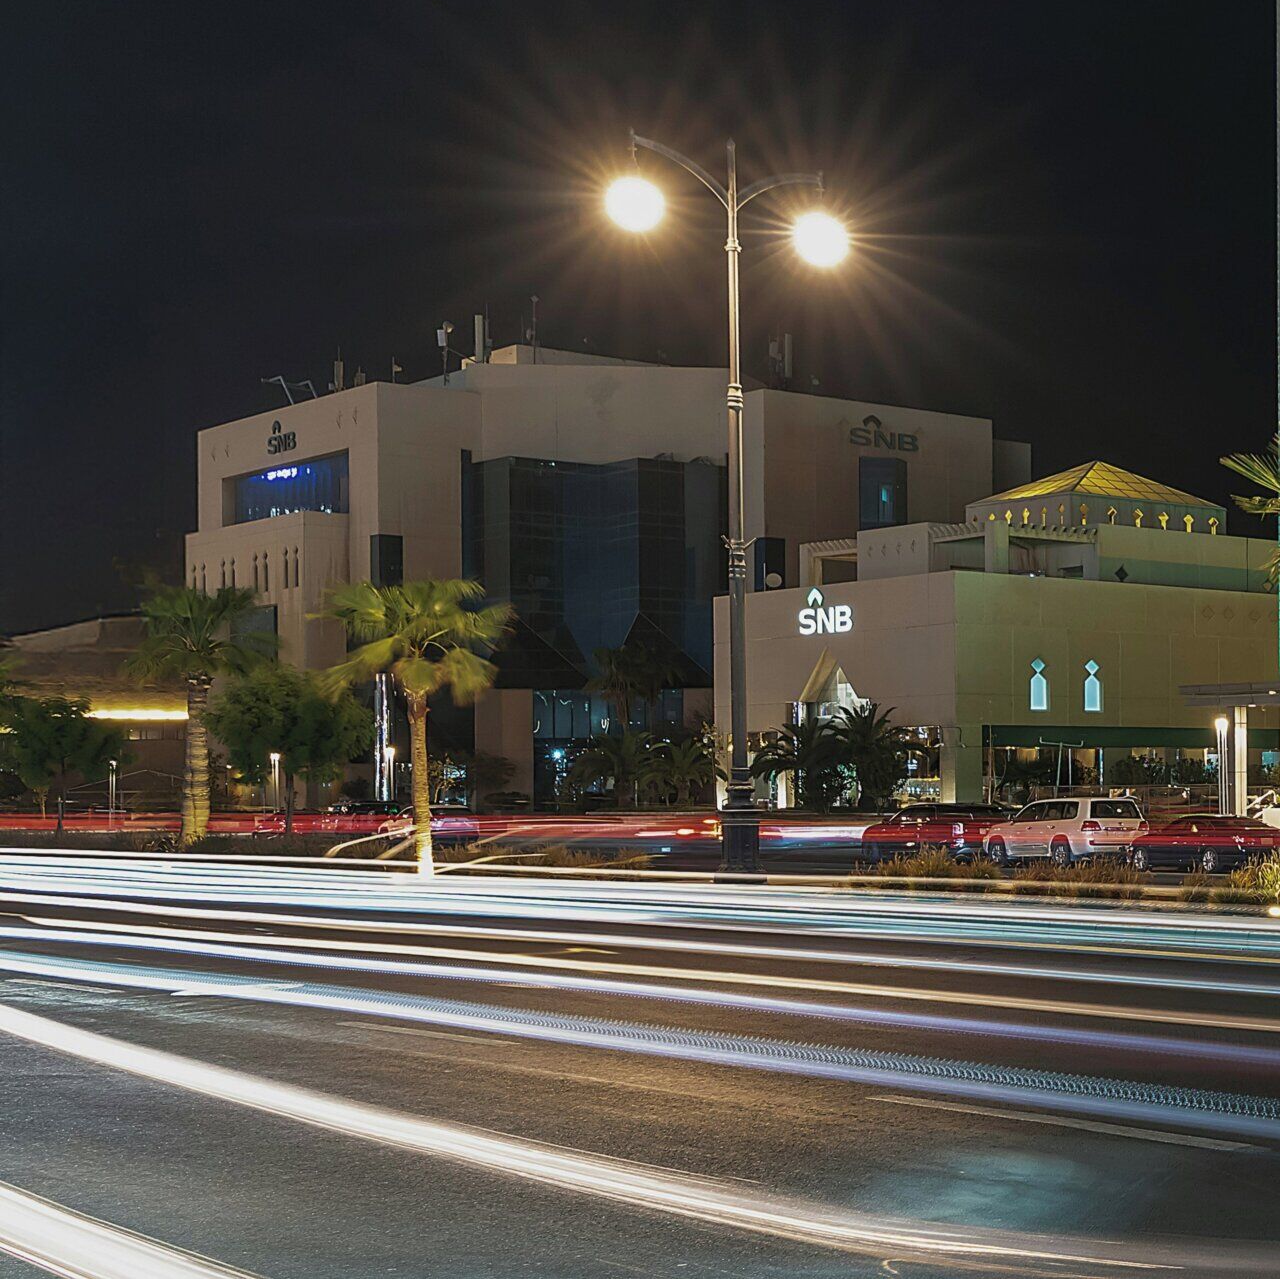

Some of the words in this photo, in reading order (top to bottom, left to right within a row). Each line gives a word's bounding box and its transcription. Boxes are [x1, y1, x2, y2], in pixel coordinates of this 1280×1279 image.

[266, 431, 297, 455] SNB
[849, 427, 919, 452] SNB
[798, 605, 853, 635] SNB
